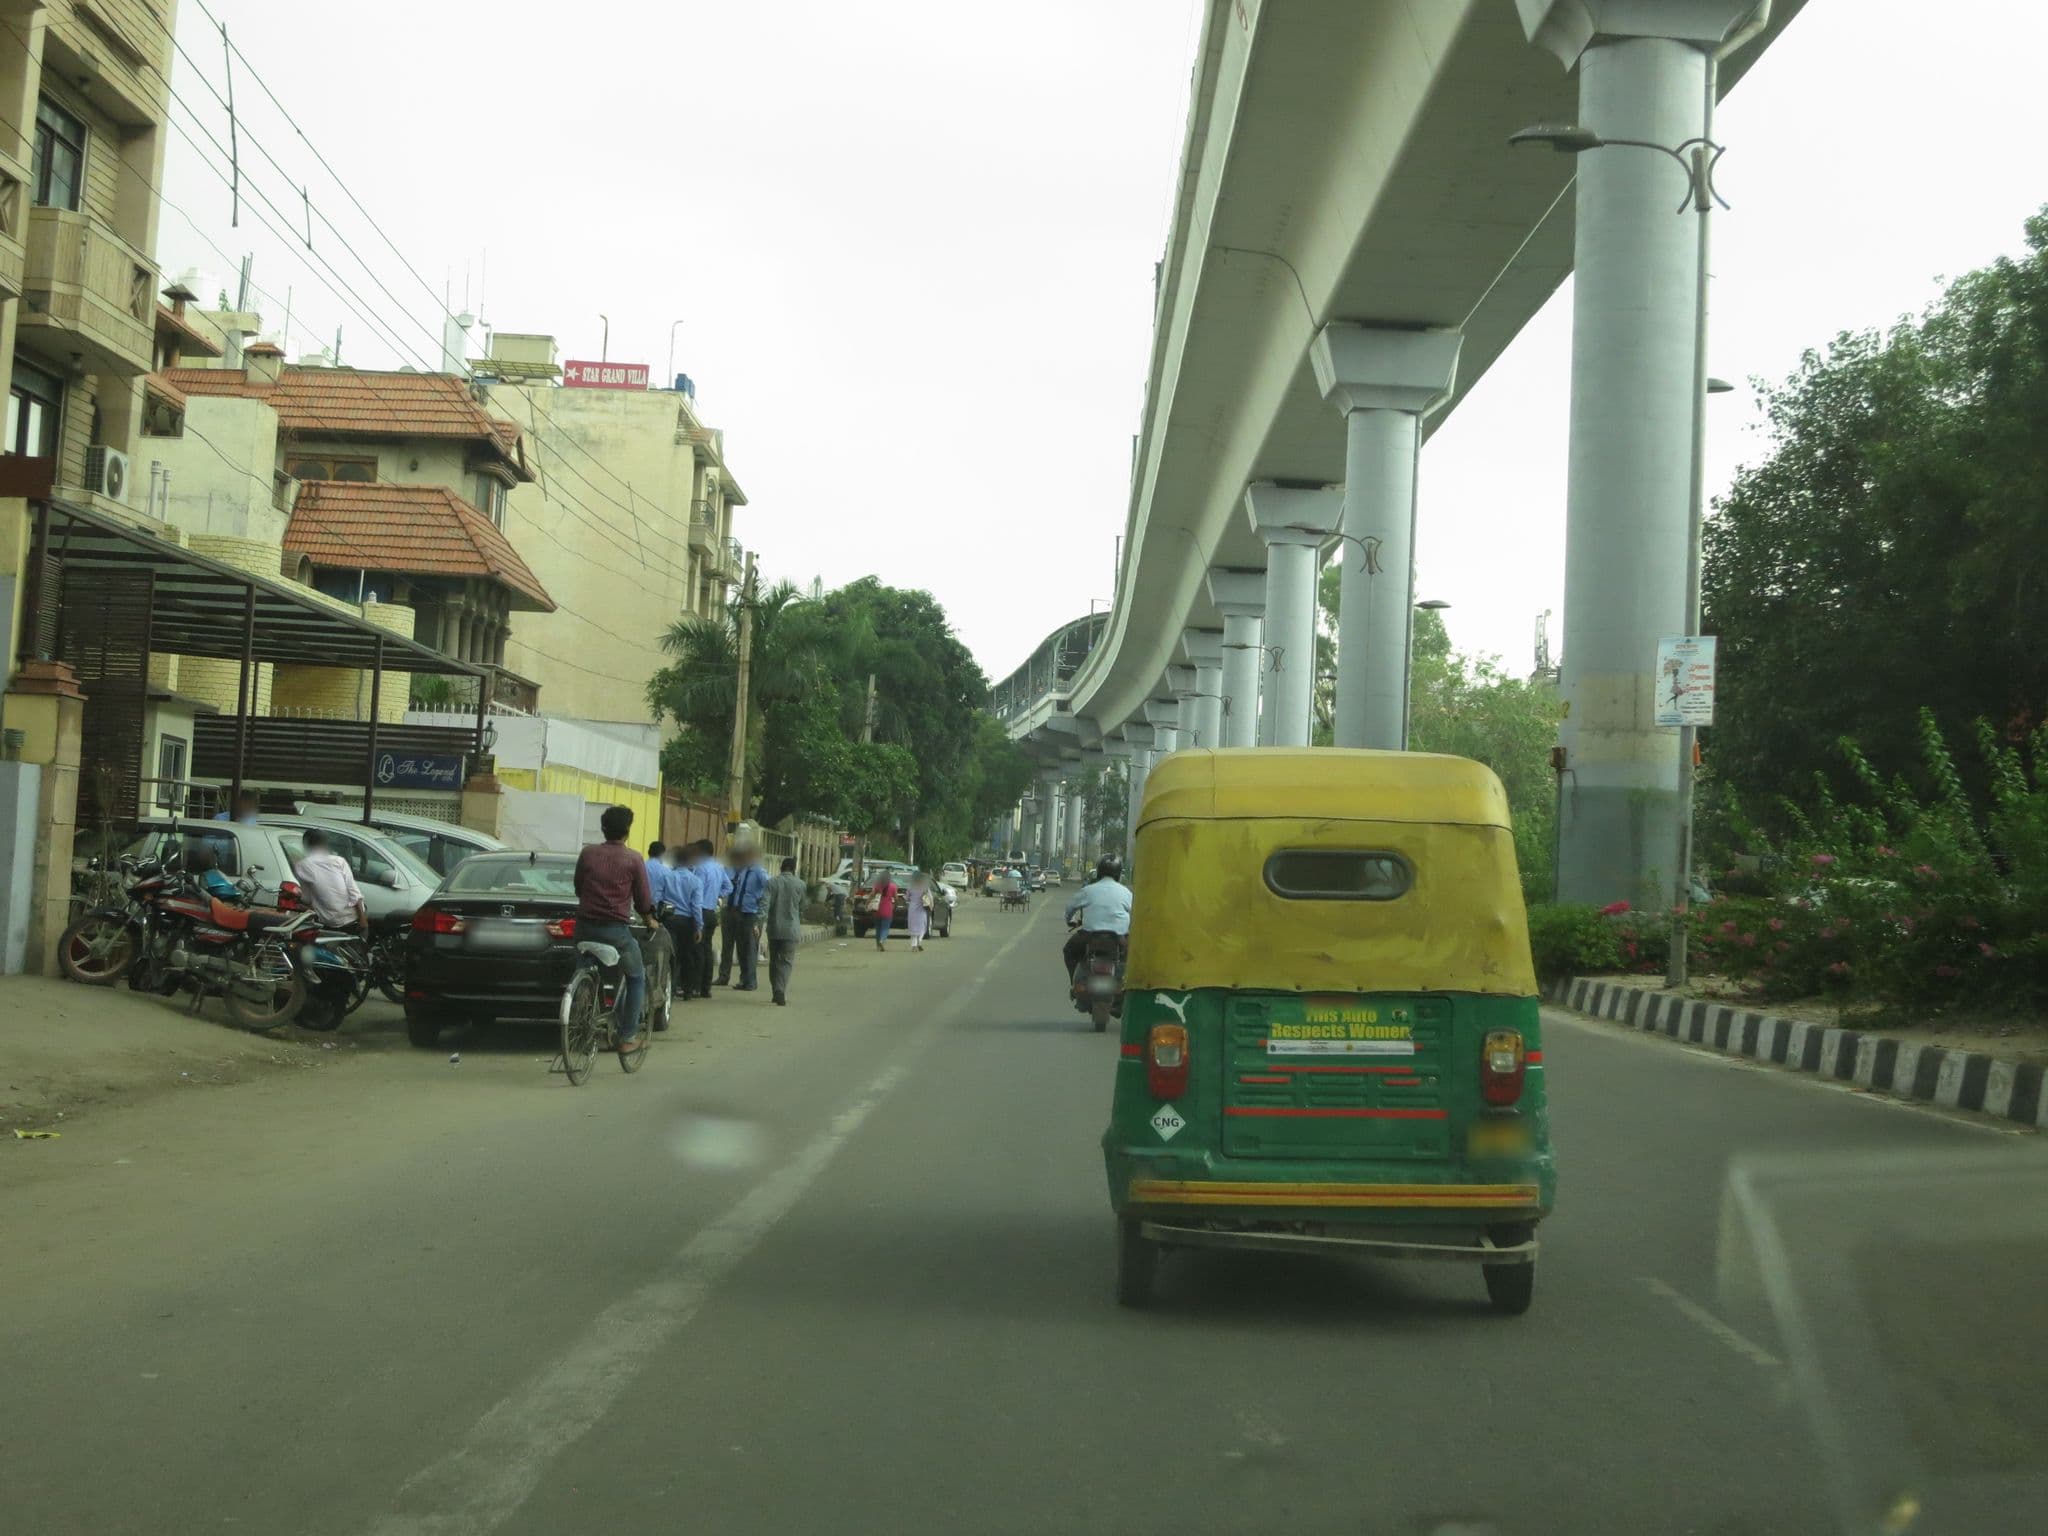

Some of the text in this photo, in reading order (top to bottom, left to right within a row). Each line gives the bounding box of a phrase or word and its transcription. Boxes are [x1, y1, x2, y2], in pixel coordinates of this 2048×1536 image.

[582, 367, 647, 385] STAR GRAND VILLA
[397, 760, 458, 782] The Legend
[1306, 1008, 1377, 1022] This Auto
[1271, 1022, 1410, 1039] Respects Women
[1153, 1116, 1180, 1128] CNG
